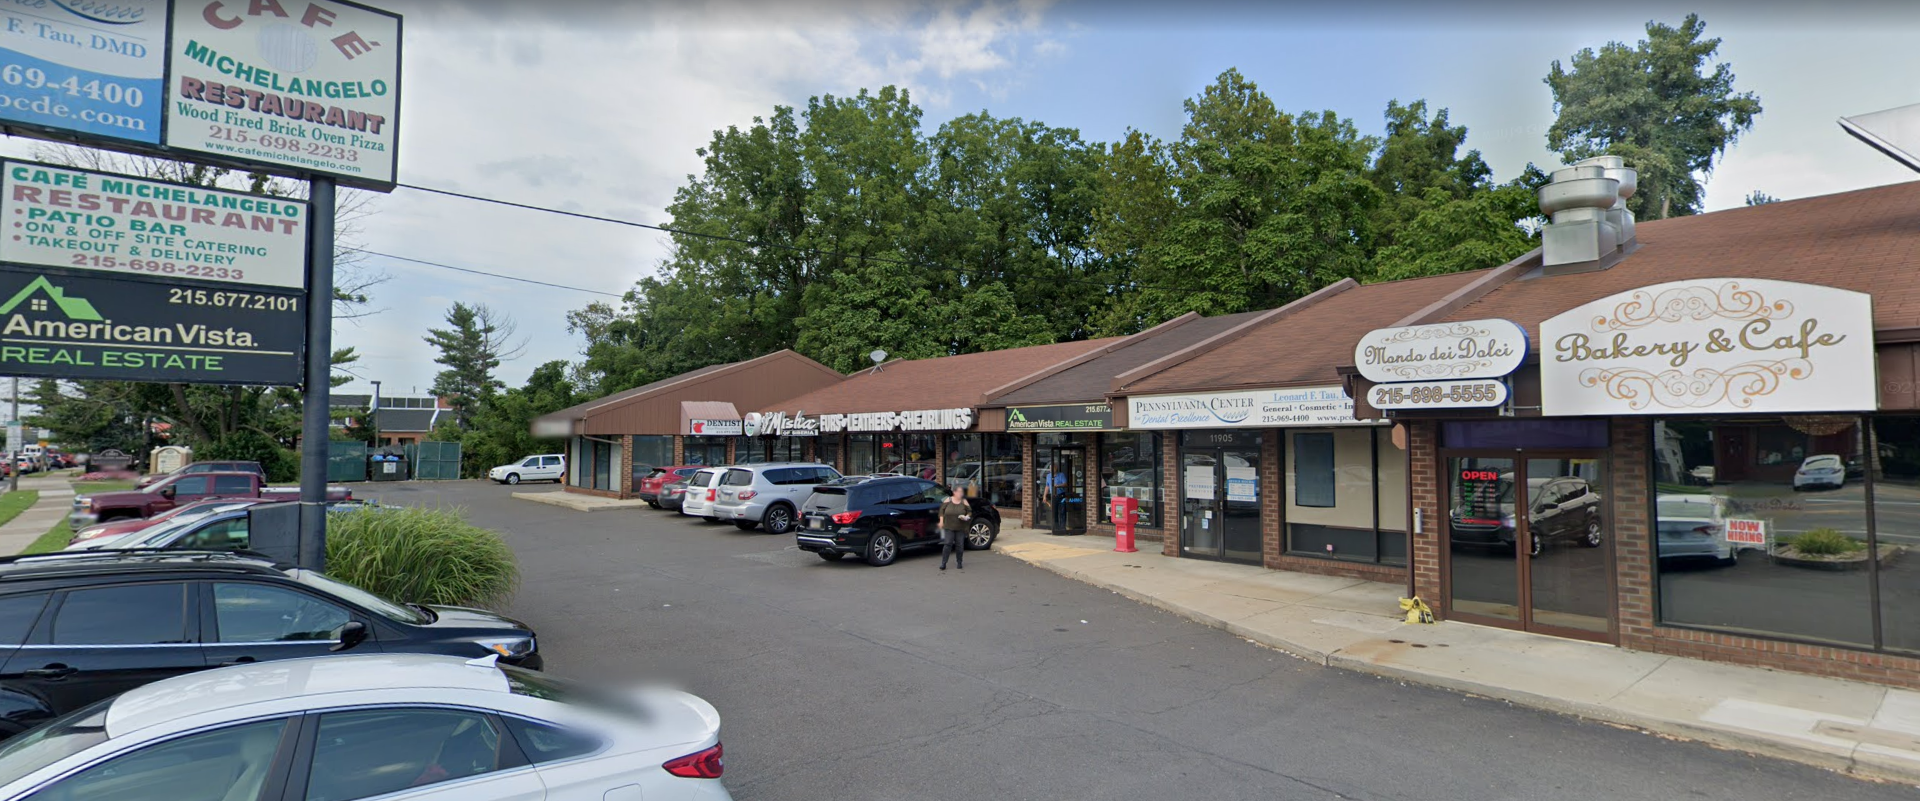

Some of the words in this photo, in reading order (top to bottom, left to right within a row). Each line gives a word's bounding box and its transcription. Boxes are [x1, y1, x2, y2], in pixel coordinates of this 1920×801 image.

[7, 17, 25, 34] F.
[33, 22, 82, 47] Tau,
[90, 34, 147, 59] DMD
[203, 0, 381, 60] CAFÉ
[184, 39, 387, 98] MICHELANGELO
[180, 75, 385, 135] RESTAURANT
[177, 101, 219, 122] Wood
[225, 111, 263, 130] Fired
[269, 119, 306, 138] Brick
[311, 128, 346, 145] Oven
[350, 135, 385, 152] Pizza
[205, 141, 361, 173] www.cafemichelangelo.com
[209, 125, 358, 162] 215-698-2233
[11, 166, 88, 189] CAFÉ
[101, 179, 299, 218] MICHELANGELO
[12, 185, 299, 235] RESTAURANT
[28, 207, 115, 228] PATIO
[129, 219, 187, 237] BAR
[25, 221, 55, 234] ON
[65, 224, 78, 237] &
[88, 228, 126, 241] OFF
[135, 234, 175, 248] SITE
[183, 239, 267, 257] CATERING
[26, 234, 119, 254] TAKEOUT
[129, 244, 141, 256] &
[151, 248, 236, 266] DELIVERY
[71, 253, 244, 280] 215-698-2233
[169, 288, 298, 312] 215.677.2101
[2, 313, 173, 344] American
[175, 323, 258, 348] Vista.
[1554, 332, 1700, 368] Bakery
[1705, 328, 1736, 354] &
[1738, 318, 1847, 360] Cafe
[1, 346, 95, 367] REAL
[101, 349, 223, 371] ESTATE
[1364, 345, 1427, 365] Mondo
[1429, 345, 1457, 361] dei
[1457, 337, 1514, 359] Dolci
[1136, 400, 1207, 414] PENNSYLVANIA
[1210, 397, 1254, 411] CENTER
[1262, 404, 1292, 413] General
[1299, 402, 1337, 412] Cosmetic
[1273, 391, 1308, 402] Leonard
[1376, 384, 1497, 405] 215-698-5555
[820, 414, 843, 432] FURS
[848, 412, 895, 431] LEATHERS
[900, 408, 971, 431] SHEARLINGS
[1010, 420, 1038, 428] American
[1141, 413, 1168, 425] Dental
[1170, 412, 1210, 424] Excellence
[1262, 414, 1309, 423] 215-969-4400
[1209, 434, 1233, 443] 11905
[1462, 470, 1498, 480] OPEN
[1727, 531, 1763, 543] HIRING
[1729, 520, 1759, 532] NOW
